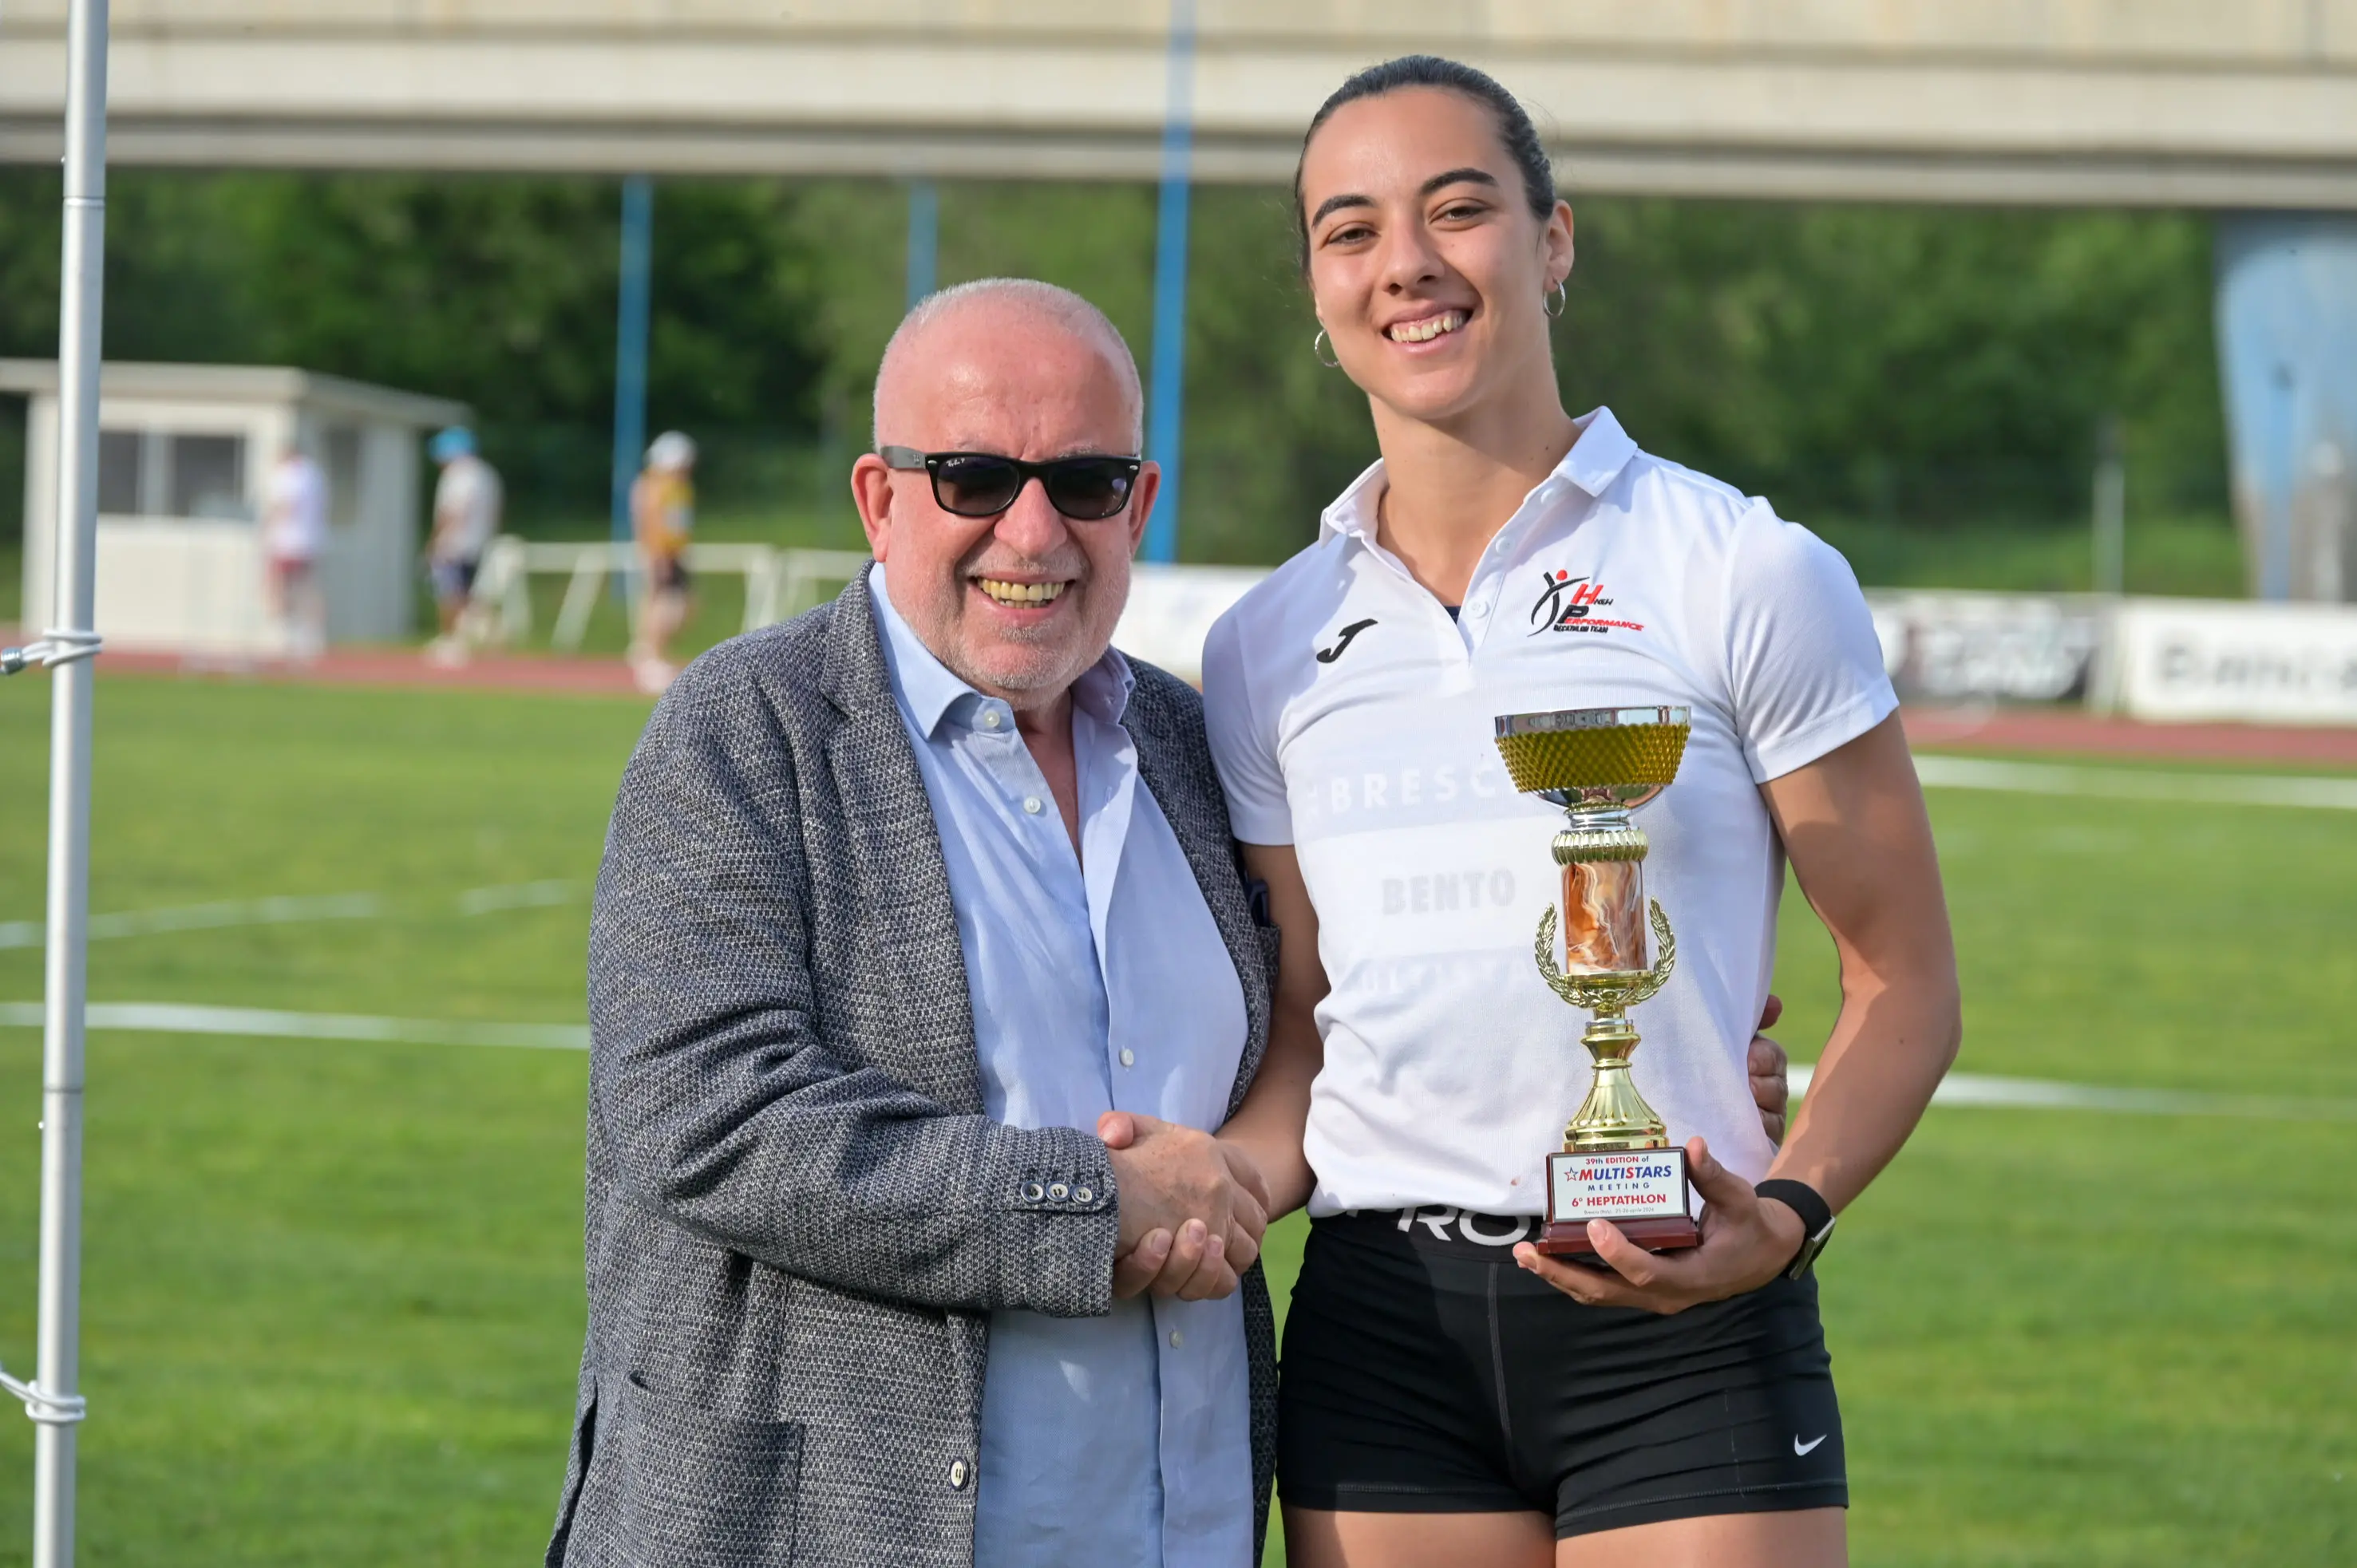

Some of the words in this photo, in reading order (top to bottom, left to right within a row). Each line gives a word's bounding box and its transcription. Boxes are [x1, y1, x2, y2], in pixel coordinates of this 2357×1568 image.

[1330, 763, 1497, 814] BRESC
[1381, 867, 1516, 916] BENTO
[1579, 1165, 1672, 1182] MULTISTARS
[1588, 1183, 1650, 1191] MEETING
[1587, 1194, 1667, 1207] HEPTATHLON
[1347, 1204, 1531, 1246] RO
